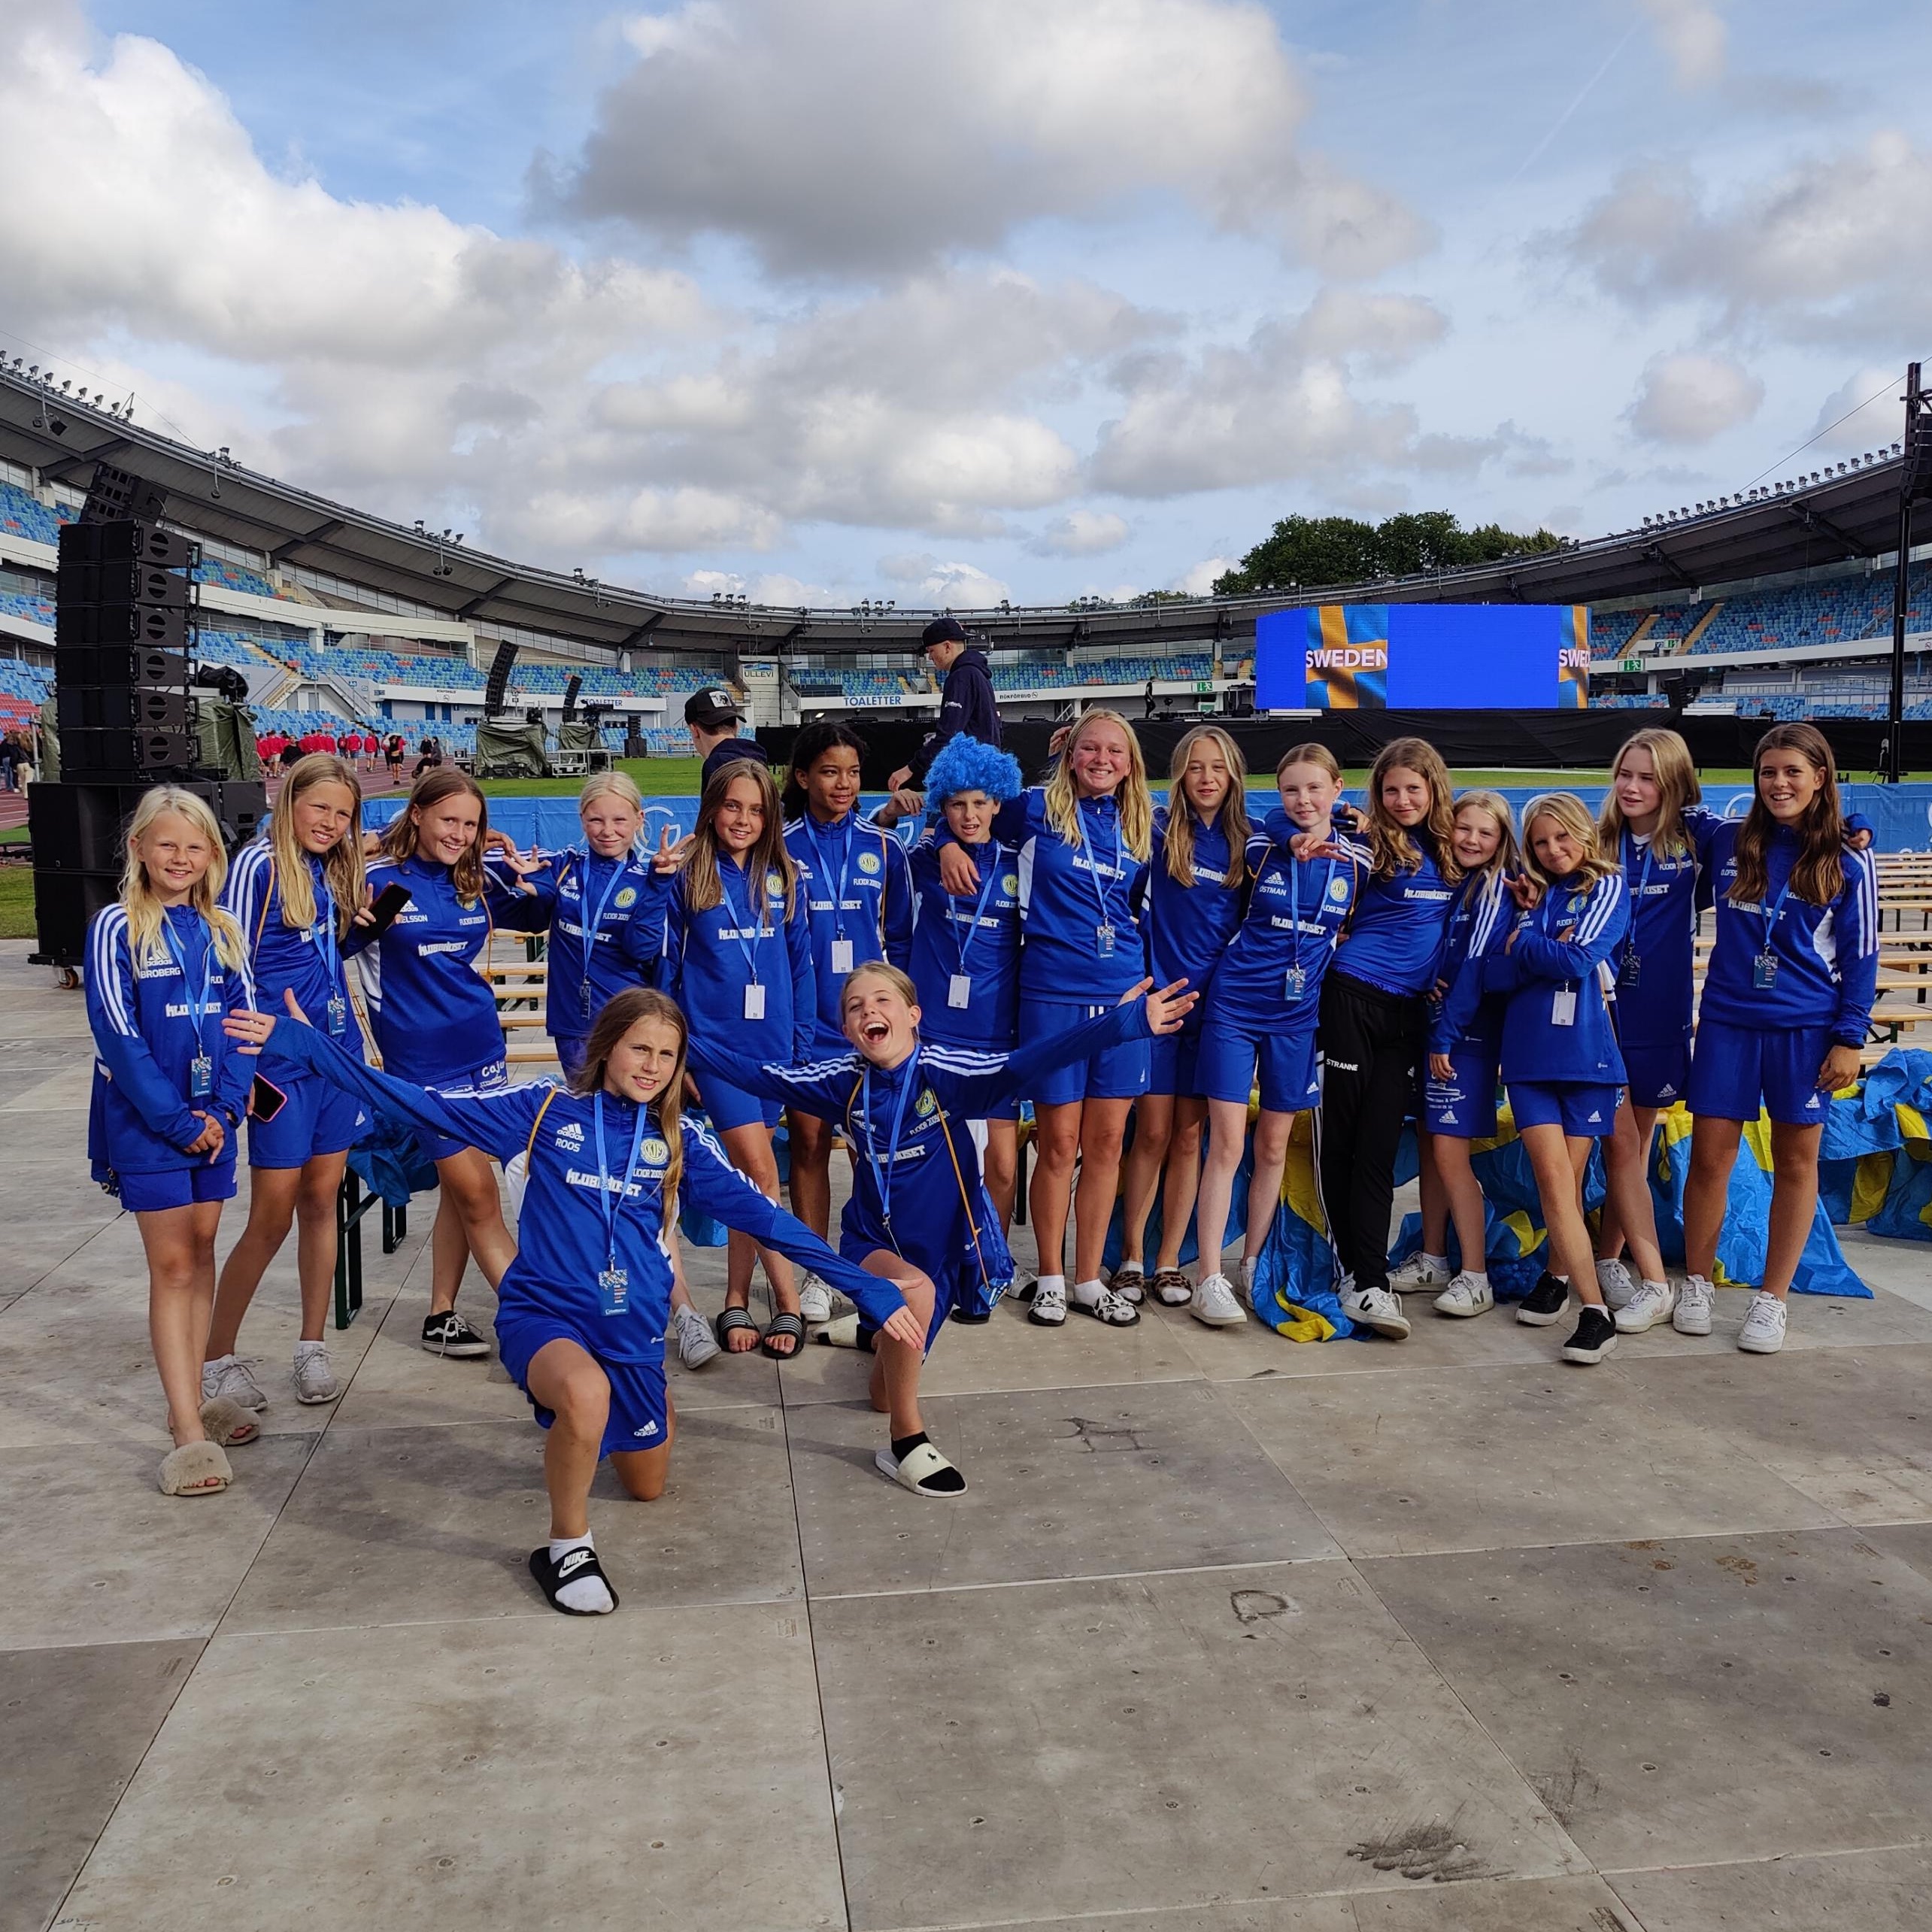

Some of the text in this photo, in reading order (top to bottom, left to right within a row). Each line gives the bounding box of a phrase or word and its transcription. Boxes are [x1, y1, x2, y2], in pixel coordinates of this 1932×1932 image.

[1306, 648, 1388, 669] SWEDEN
[844, 696, 902, 706] TOALETTER
[140, 966, 181, 979] BROBERG
[1326, 1058, 1359, 1072] STRANNE
[554, 1137, 581, 1153] ROOS
[563, 1550, 590, 1569] NIKE
